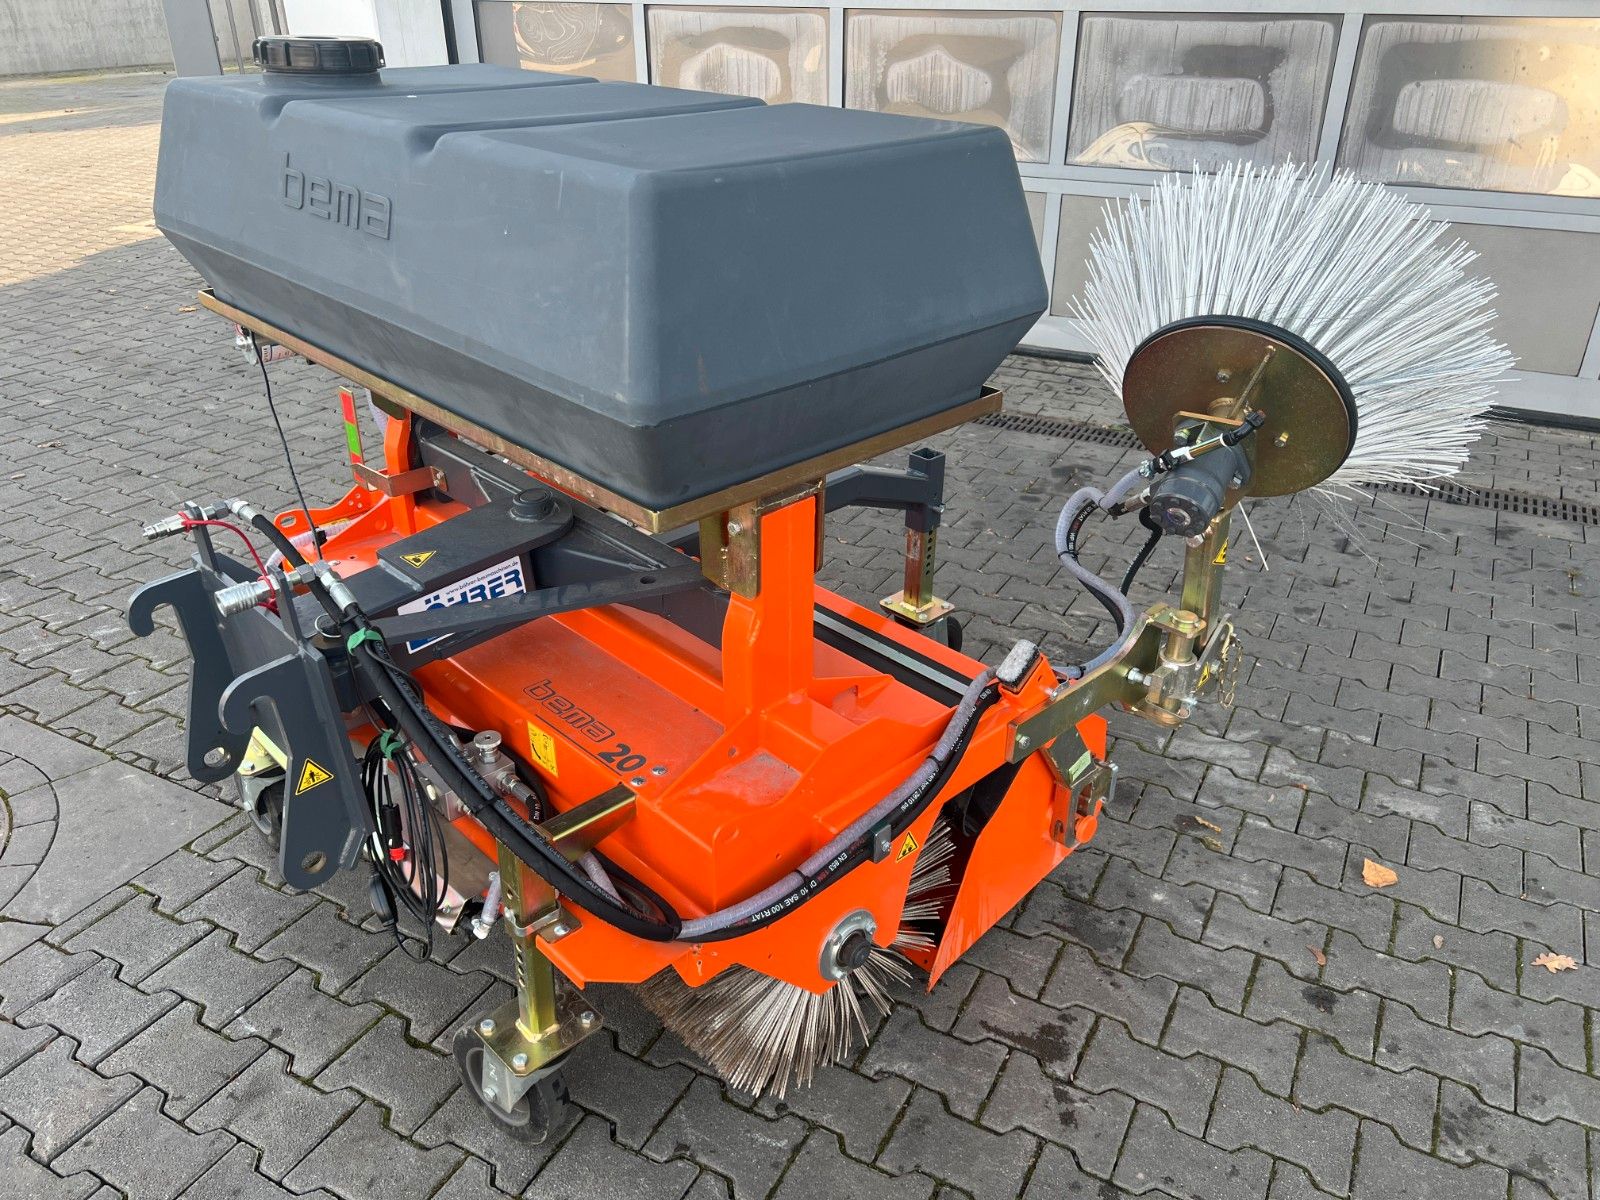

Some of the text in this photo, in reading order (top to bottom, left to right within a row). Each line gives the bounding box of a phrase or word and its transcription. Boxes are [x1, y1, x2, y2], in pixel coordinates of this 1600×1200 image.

[280, 152, 393, 240] bema
[523, 679, 616, 743] bema
[598, 743, 647, 772] 20
[838, 852, 848, 862] EN
[800, 886, 809, 896] 10
[783, 893, 799, 906] SAE
[771, 903, 784, 914] 100
[751, 910, 771, 922] R1AT
